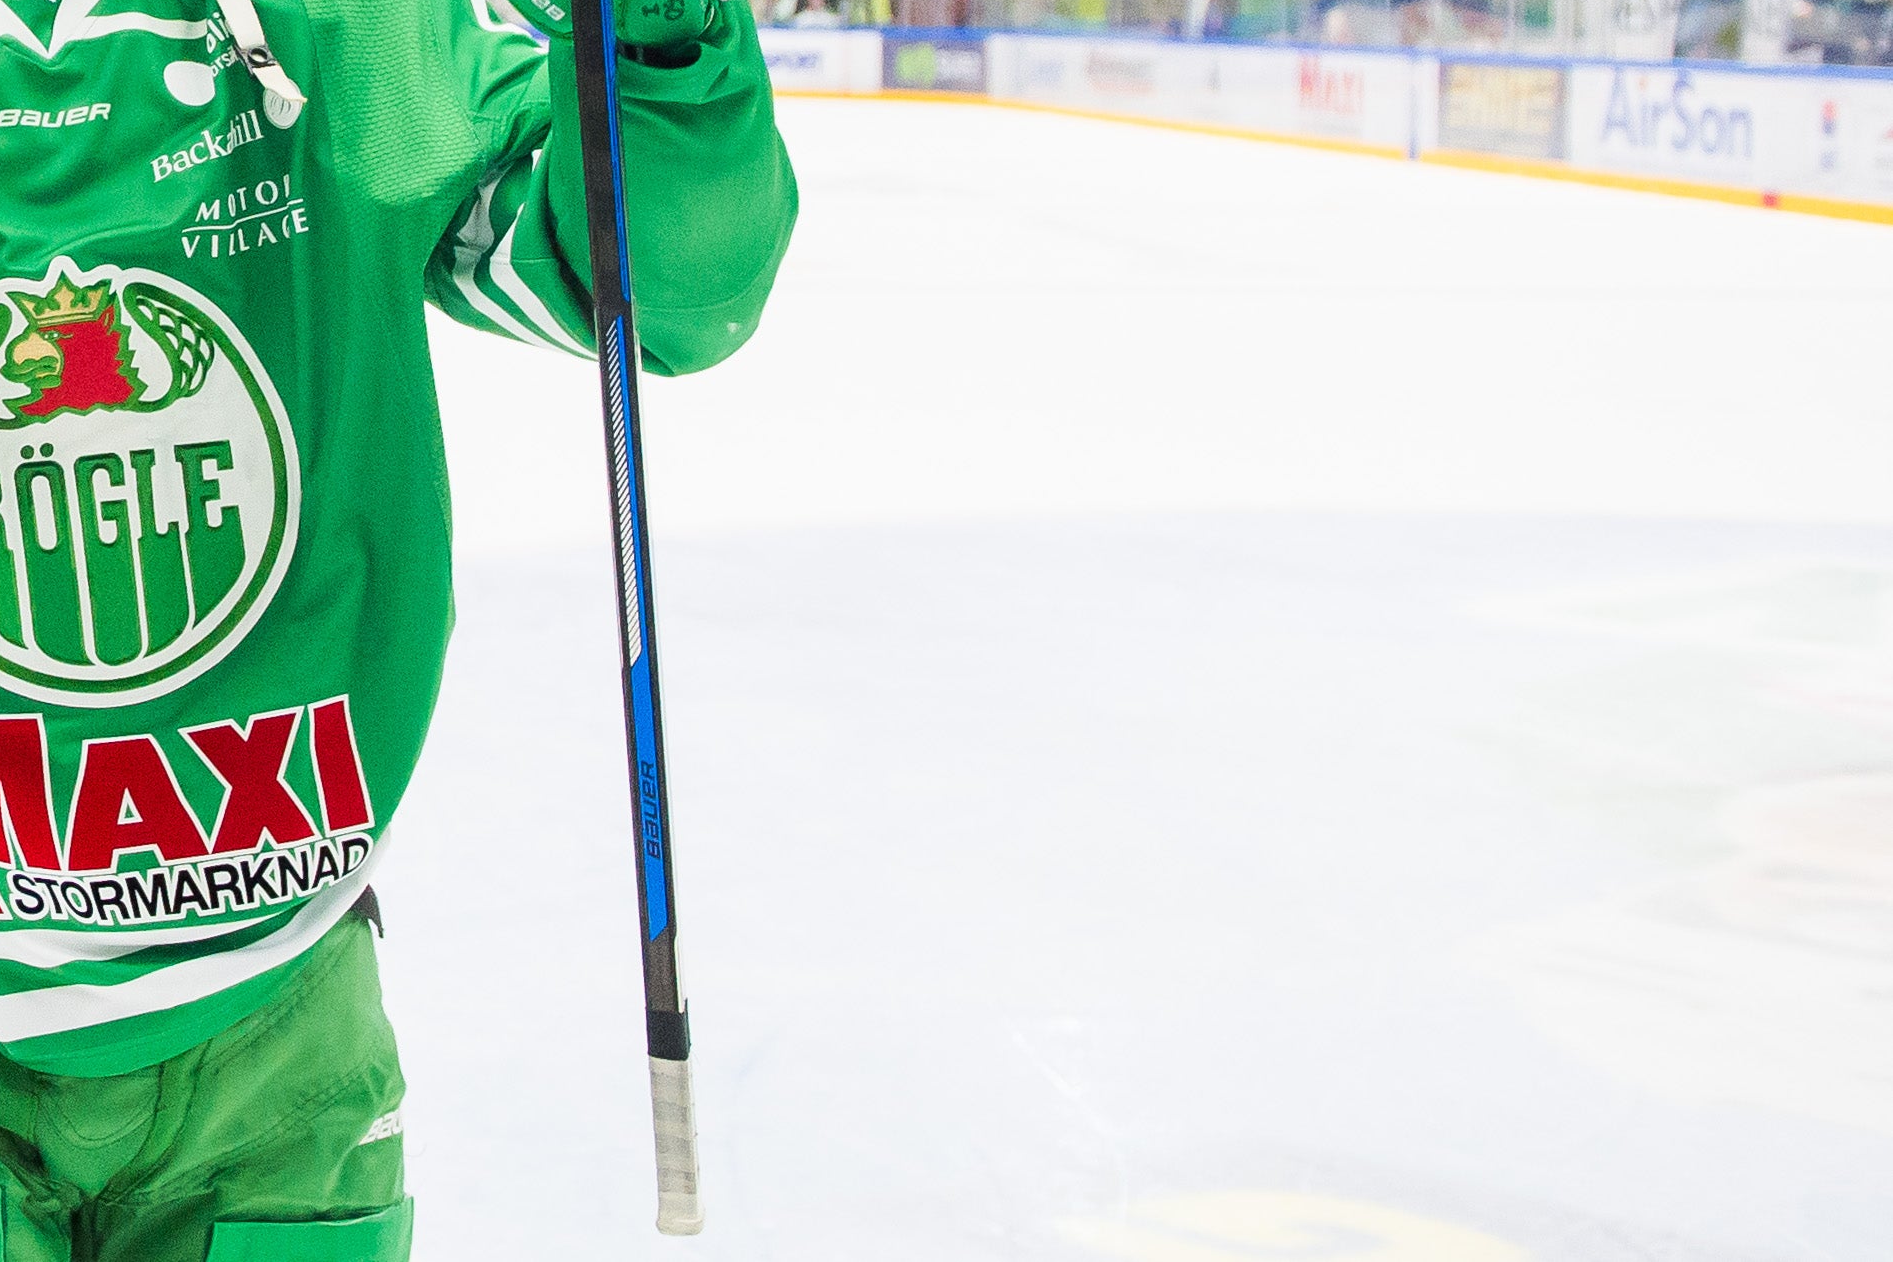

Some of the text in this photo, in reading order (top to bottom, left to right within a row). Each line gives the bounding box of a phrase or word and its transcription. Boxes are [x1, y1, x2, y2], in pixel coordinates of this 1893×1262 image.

[1603, 64, 1755, 159] AirSon
[640, 760, 663, 861] BAUER
[10, 837, 371, 924] STORMARKNAD
